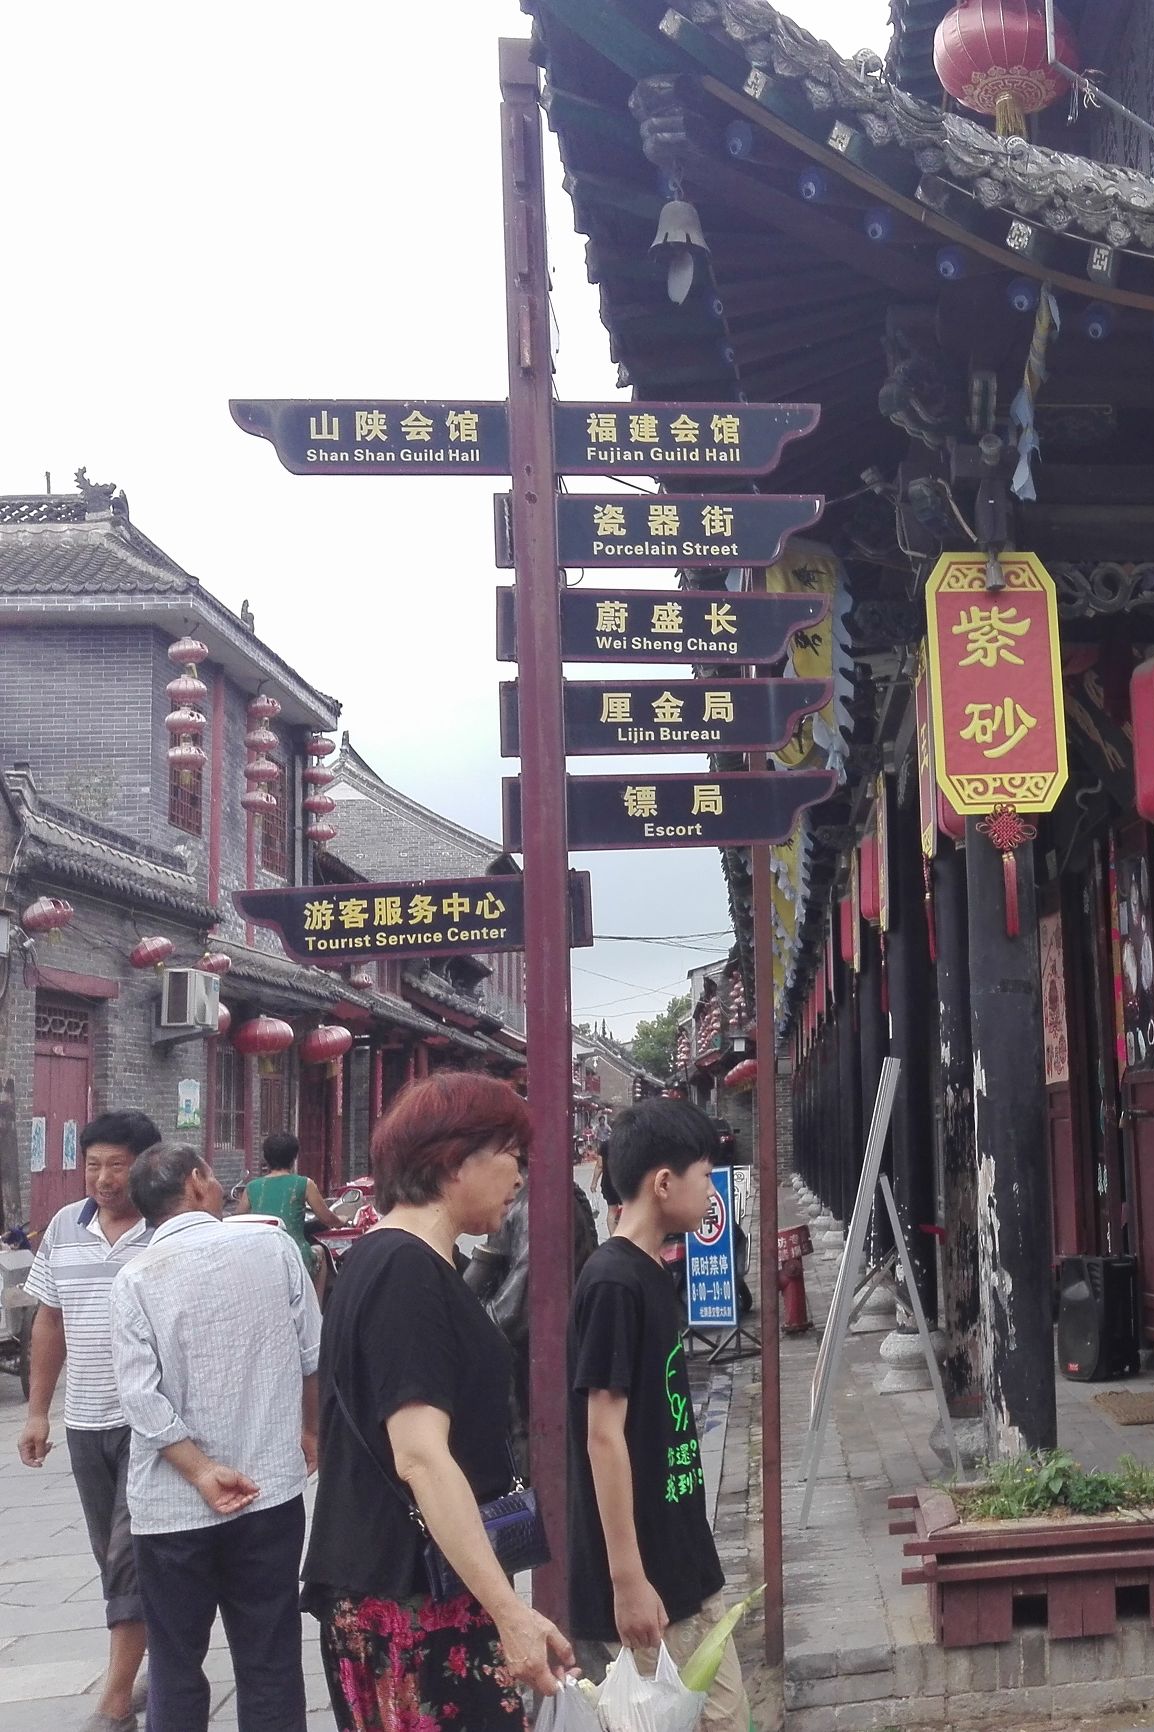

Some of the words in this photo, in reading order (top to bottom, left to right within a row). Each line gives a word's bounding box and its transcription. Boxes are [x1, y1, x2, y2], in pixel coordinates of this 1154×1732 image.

[310, 410, 478, 443] 山陕会馆
[587, 413, 739, 444] 福建会馆
[307, 449, 349, 461] Shan
[354, 449, 395, 461] Shan
[400, 449, 444, 461] Guild
[448, 449, 479, 461] Hall
[587, 447, 643, 463] Fujian
[650, 448, 699, 461] Guild
[706, 448, 740, 461] Hall
[593, 504, 733, 536] 瓷器街
[593, 542, 677, 555] Porcelain
[683, 542, 738, 555] Street
[596, 601, 737, 635] 蔚盛长
[596, 637, 626, 649] Wei
[632, 637, 682, 653] Sheng
[687, 638, 737, 654] Chang
[952, 605, 1037, 758] 紫砂
[600, 691, 733, 723] 厘金局
[618, 728, 654, 743] Lijin
[660, 728, 720, 740] Bureau
[624, 785, 722, 817] 镖局
[645, 823, 702, 836] Escort
[304, 892, 506, 931] 游客服务中心
[305, 935, 371, 950] Tourist
[376, 932, 442, 946] Service
[448, 928, 506, 941] Center
[691, 1254, 728, 1276] 限时禁停
